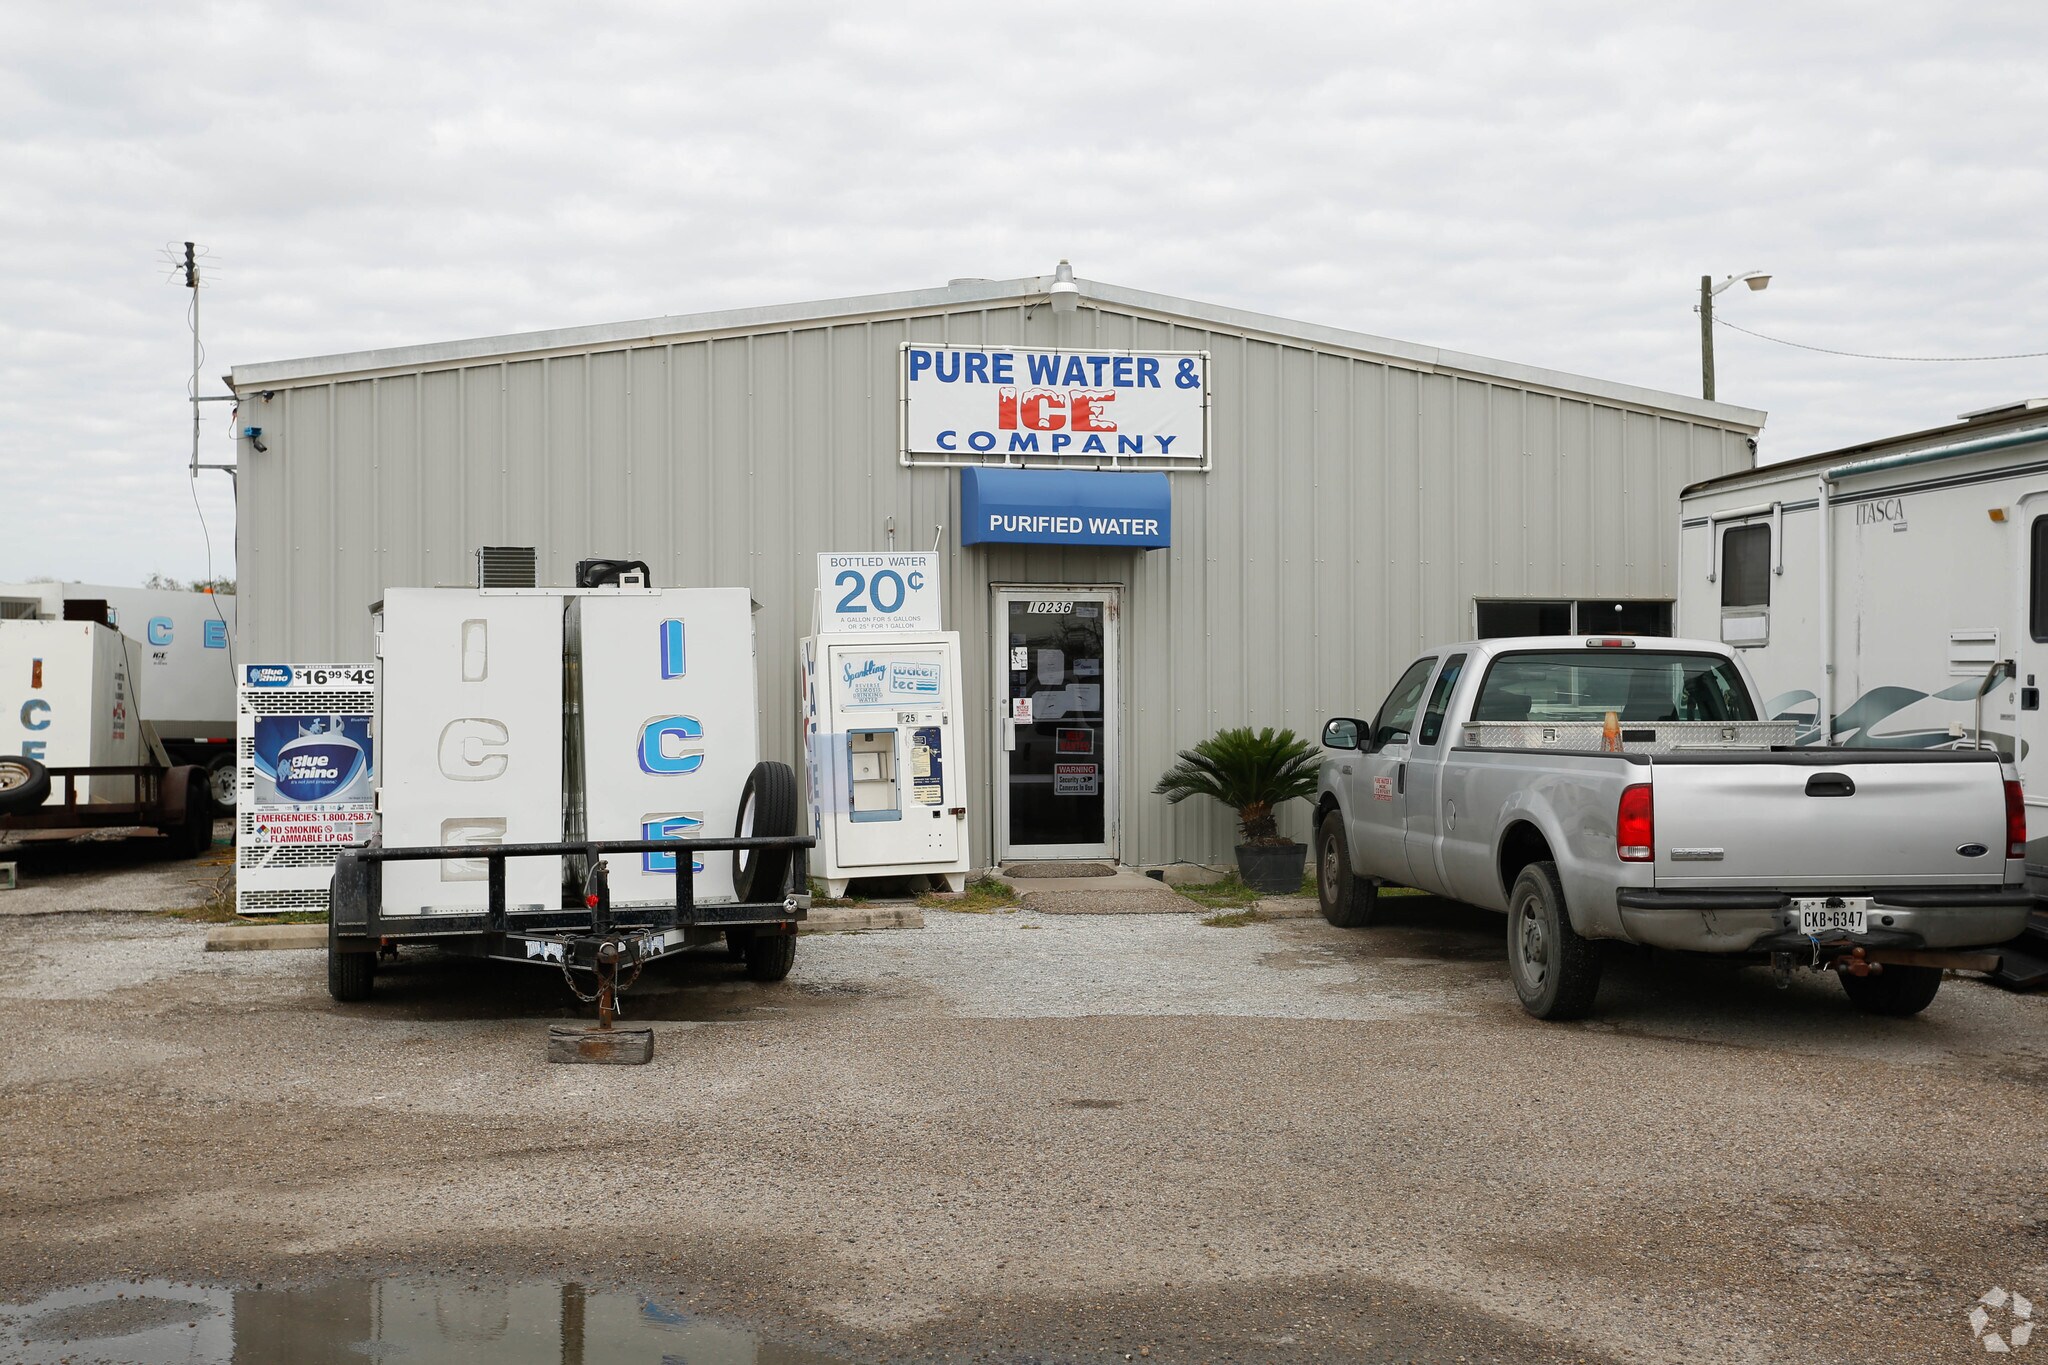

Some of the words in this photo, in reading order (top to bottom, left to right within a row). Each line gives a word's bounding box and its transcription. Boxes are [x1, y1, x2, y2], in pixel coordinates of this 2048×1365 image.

[909, 350, 1014, 384] PURE
[1026, 354, 1161, 388] WATER
[1174, 358, 1201, 390] &
[998, 386, 1118, 432] ICE
[936, 430, 1177, 455] COMPANY
[1855, 499, 1904, 526] ITASCA
[989, 515, 1083, 534] PURIFIED
[1088, 517, 1159, 536] WATER
[830, 557, 884, 567] BOTTLED
[888, 556, 926, 567] WATER
[1031, 602, 1072, 613] 10236
[843, 660, 888, 689] Sparkling
[893, 662, 935, 676] water
[259, 674, 288, 682] Rhino
[892, 676, 914, 690] tec
[905, 714, 915, 723] 25
[292, 754, 329, 767] Blue
[288, 767, 338, 780] Rhino
[1058, 765, 1094, 773] WARNING
[1059, 776, 1079, 784] Security
[256, 813, 320, 822] EMERGENCIES:
[270, 826, 282, 834] NO
[284, 825, 323, 834] SMOKING
[270, 834, 322, 843] FLAMMABLE
[325, 833, 335, 842] LP
[336, 833, 353, 842] GAS
